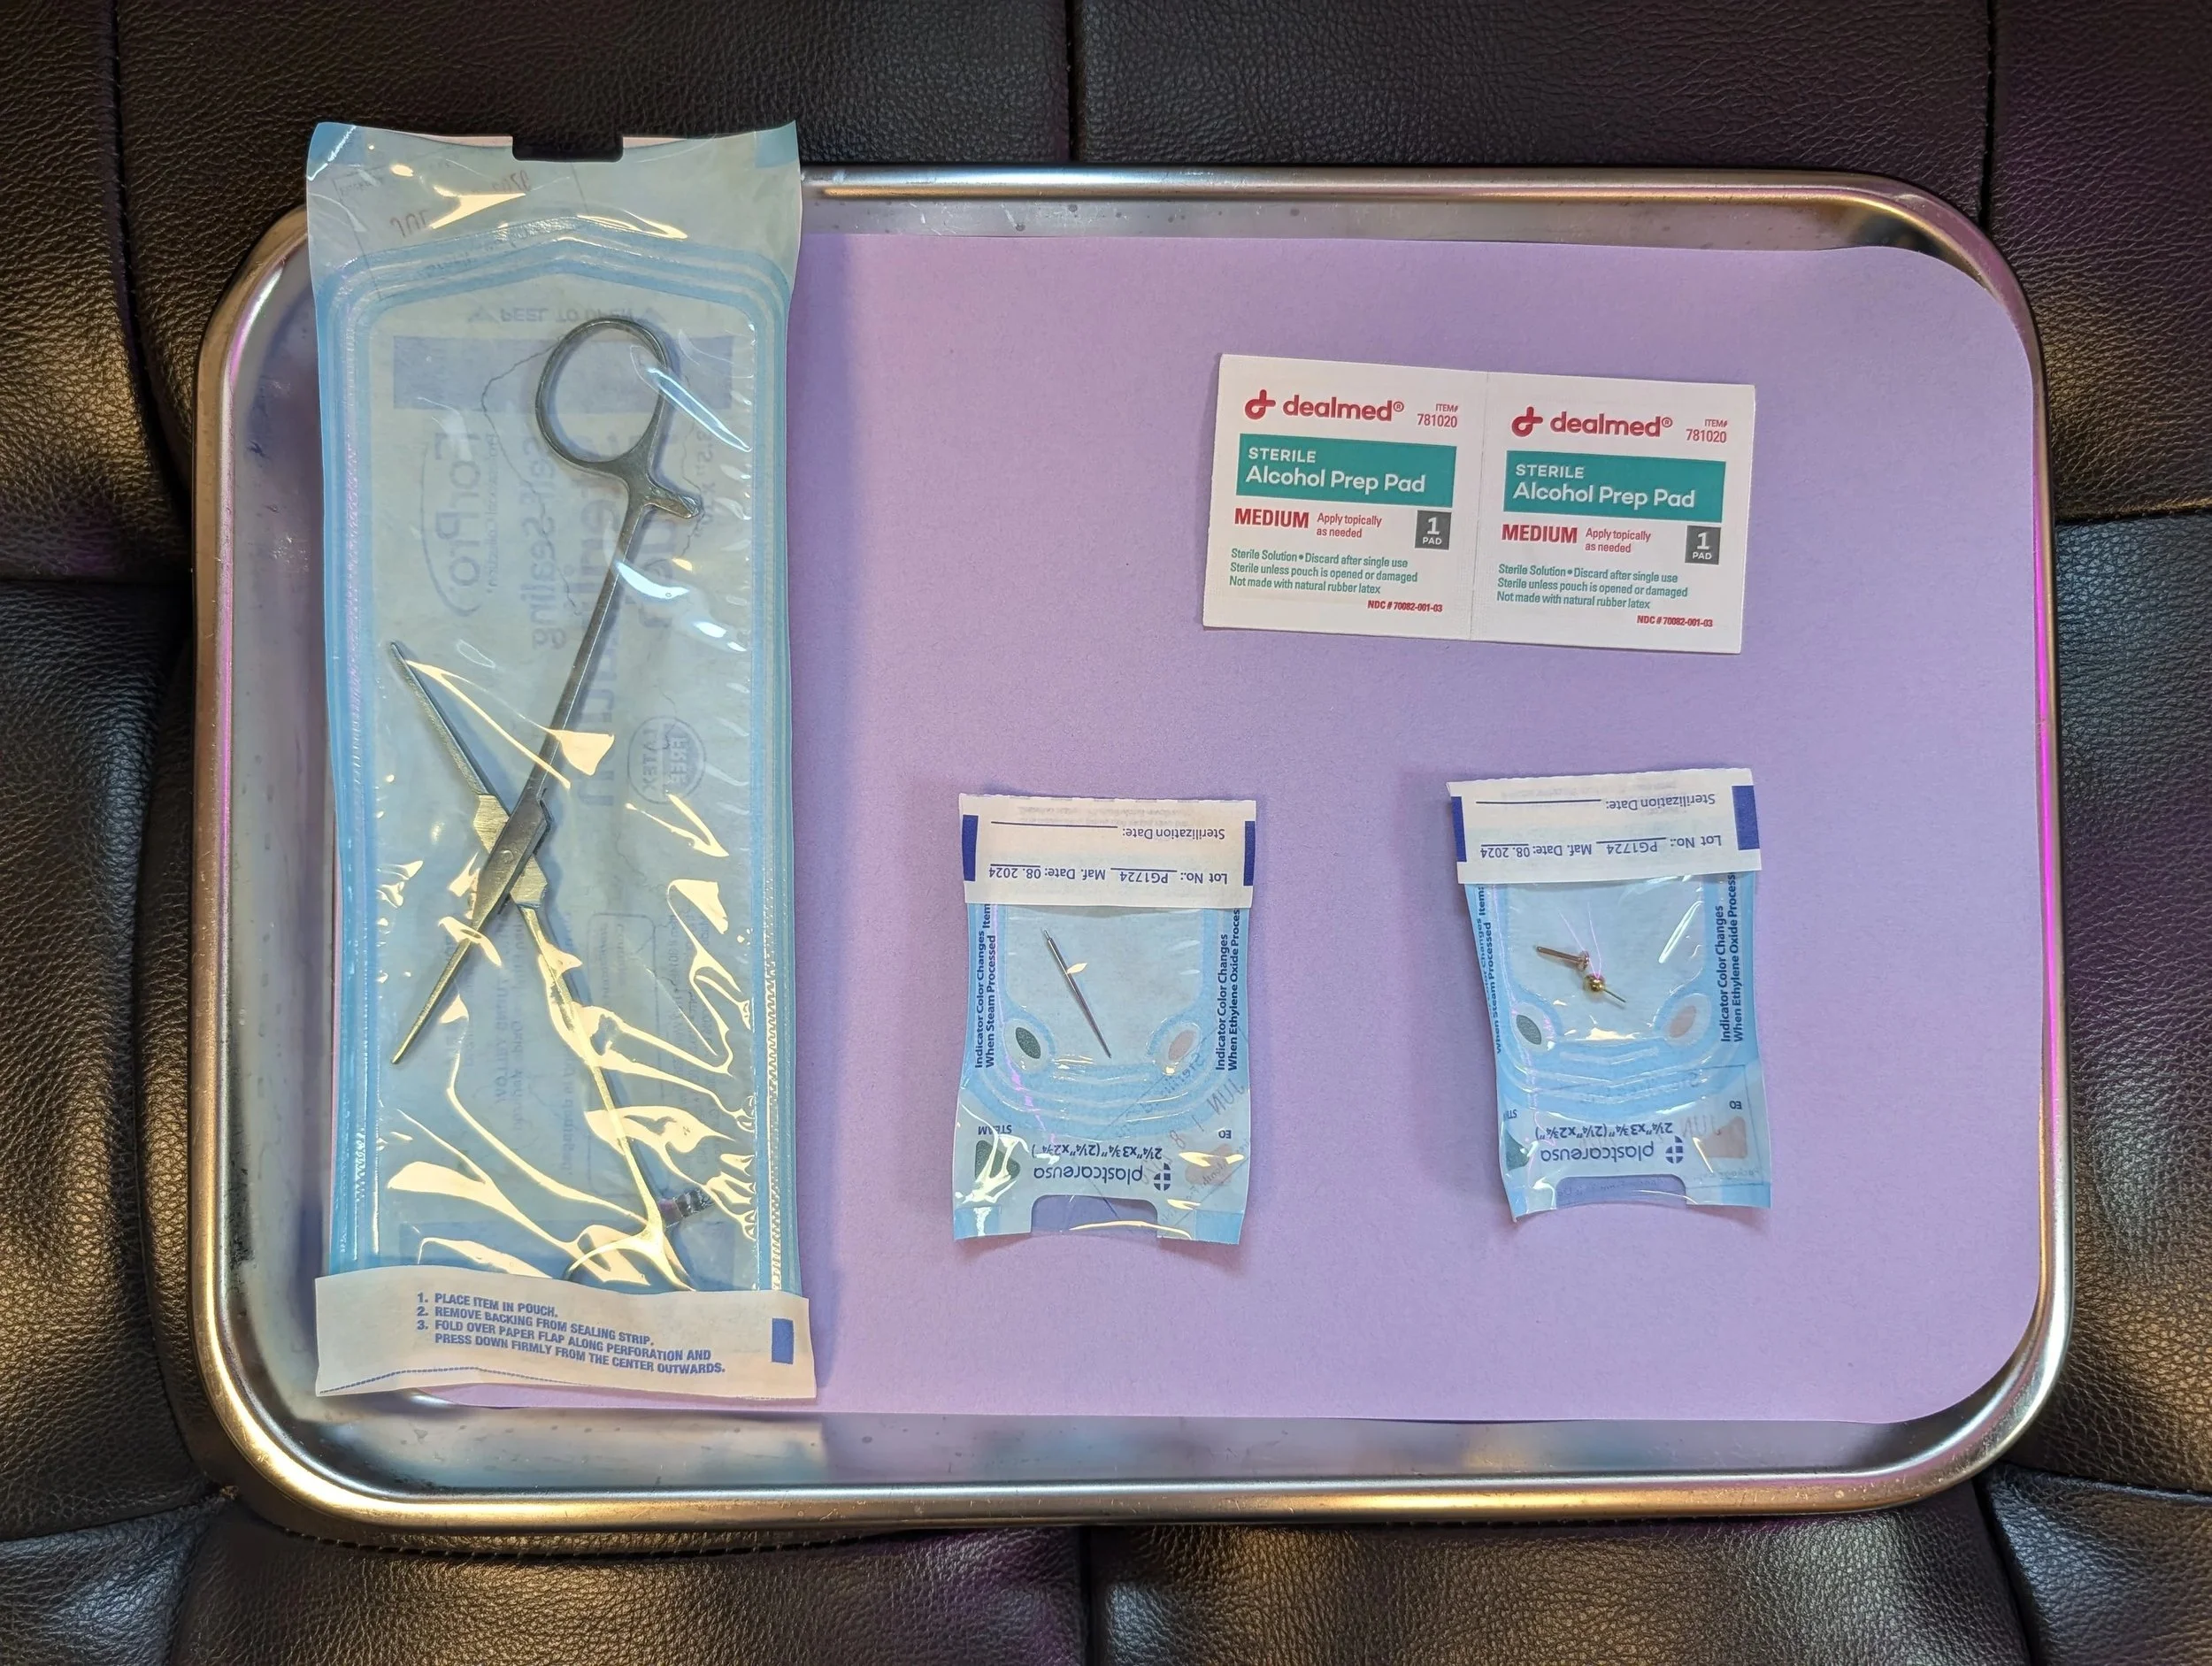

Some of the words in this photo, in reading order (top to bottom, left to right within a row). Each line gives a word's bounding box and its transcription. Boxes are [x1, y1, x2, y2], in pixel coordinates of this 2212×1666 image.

[1435, 403, 1458, 412] ITEM#
[1417, 413, 1457, 427] 781020
[1686, 429, 1726, 442] 781020
[1248, 447, 1316, 464] STERILE
[1246, 466, 1325, 488] Alcohol
[1331, 471, 1379, 495] Prep
[1385, 473, 1425, 493] Pad
[1516, 464, 1585, 479] STERILE
[1513, 482, 1593, 503] Alcohol
[1599, 486, 1647, 510] Prep
[1654, 489, 1695, 508] Pad
[1234, 508, 1310, 528] MEDIUM
[1317, 513, 1343, 526] Apply
[1344, 514, 1382, 527] topically
[1427, 517, 1440, 535] 1
[1329, 528, 1362, 538] needed
[1502, 524, 1578, 543] MEDIUM
[1586, 527, 1612, 541] Apply
[1613, 530, 1651, 542] topically
[1697, 532, 1709, 550] 1
[1598, 542, 1631, 553] needed
[1232, 549, 1260, 559] Sterile
[1262, 550, 1297, 562] Solution
[1305, 553, 1339, 564] Discard
[1341, 555, 1362, 565] after
[1363, 556, 1390, 569] single
[1391, 559, 1408, 568] use
[1231, 563, 1258, 573] Sterile
[1261, 564, 1289, 575] unless
[1291, 566, 1318, 579] pouch
[1320, 567, 1328, 577] is
[1330, 569, 1363, 580] opened
[1377, 572, 1417, 584] damaged
[1499, 564, 1528, 574] Sterile
[1530, 565, 1565, 577] Solution
[1574, 568, 1608, 580] Discard
[1610, 570, 1631, 580] after
[1633, 571, 1659, 584] single
[1661, 574, 1678, 583] use
[1230, 576, 1246, 587] Not
[1248, 577, 1272, 588] made
[1274, 580, 1293, 589] with
[1295, 580, 1326, 591] natural
[1328, 582, 1356, 593] rubber
[1359, 584, 1380, 594] latex
[1498, 579, 1527, 588] Sterile
[1529, 580, 1558, 590] unless
[1560, 581, 1587, 594] pouch
[1590, 583, 1597, 592] is
[1600, 584, 1632, 595] opened
[1646, 587, 1687, 598] damaged
[1367, 600, 1386, 610] NDC
[1394, 602, 1442, 612] 70082-001-03
[1637, 616, 1655, 625] NDC
[1663, 617, 1713, 627] 70082-001-03
[1606, 797, 1638, 810] Date:
[1641, 794, 1716, 808] Sterilization
[1123, 828, 1153, 840] Date:
[1156, 827, 1225, 840] Sterilization
[1670, 836, 1694, 848] No.:
[1700, 834, 1722, 847] Lot
[1480, 847, 1509, 860] 2024
[1512, 846, 1530, 858] 08.
[1532, 845, 1563, 856] Date:
[1568, 843, 1592, 856] Maf.
[1606, 841, 1657, 856] PG1724
[988, 866, 1018, 879] 2024
[1023, 867, 1041, 879] 08.
[1044, 867, 1075, 879] Date:
[1081, 868, 1106, 880] Maf.
[1120, 870, 1169, 884] PG1724
[1180, 871, 1203, 884] No.:
[1209, 871, 1228, 885] Lot
[1715, 905, 1726, 956] Changes
[1729, 920, 1739, 954] Oxide
[977, 930, 987, 980] Changes
[1217, 933, 1230, 983] Changes
[1483, 922, 1494, 979] Processed
[987, 935, 996, 992] Processed
[1230, 950, 1239, 983] Oxide
[1717, 958, 1727, 988] Color
[1730, 956, 1742, 1006] Ethylene
[1217, 986, 1227, 1017] Color
[1229, 987, 1240, 1033] Ethylene
[987, 996, 995, 1032] Steam
[1720, 990, 1731, 1042] Indicator
[1733, 1008, 1743, 1042] When
[986, 1033, 995, 1068] When
[1216, 1018, 1225, 1071] Indicator
[1227, 1036, 1238, 1071] When
[1729, 1101, 1742, 1110] EO
[1218, 1130, 1232, 1140] EO
[1540, 1141, 1655, 1162] plastcareusa
[1033, 1164, 1143, 1185] plastcareusa
[417, 1293, 428, 1303] 1.
[434, 1293, 471, 1306] PLACE
[473, 1297, 499, 1310] ITEM
[503, 1301, 514, 1312] IN
[518, 1302, 558, 1317] POUCH.
[417, 1306, 428, 1317] 2.
[434, 1307, 482, 1320] REMOVE
[485, 1312, 533, 1327] BACKING
[536, 1317, 567, 1332] FROM
[571, 1323, 616, 1340] SEALING
[618, 1332, 654, 1346] STRIP.
[417, 1319, 429, 1331] 3.
[434, 1320, 464, 1332] FOLD
[466, 1322, 495, 1335] OVER
[499, 1325, 534, 1340] PAPER
[538, 1331, 565, 1345] FLAP
[568, 1336, 603, 1352] ALONG
[607, 1342, 683, 1362] PERFORATION
[687, 1349, 711, 1361] AND
[434, 1333, 472, 1345] PRESS
[475, 1335, 508, 1348] DOWN
[511, 1340, 552, 1355] FIRMLY
[555, 1346, 586, 1362] FROM
[588, 1352, 610, 1365] THE
[611, 1356, 654, 1372] CENTER
[657, 1363, 726, 1375] OUTWARDS.
